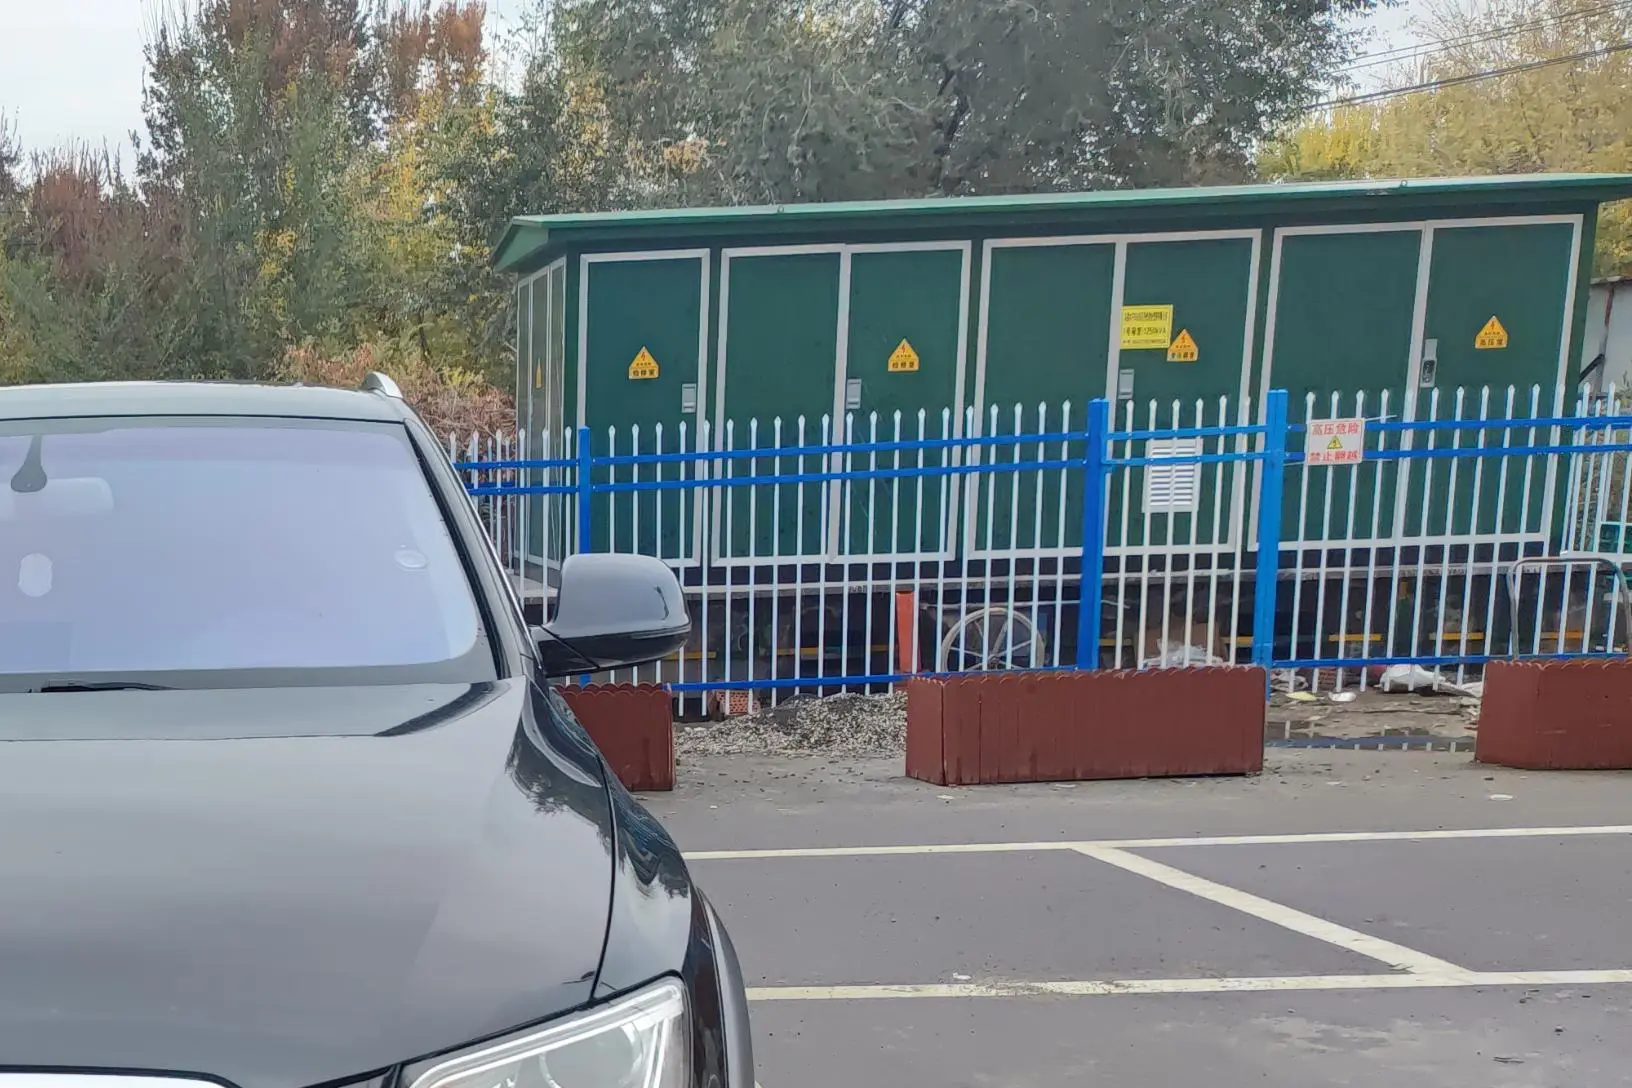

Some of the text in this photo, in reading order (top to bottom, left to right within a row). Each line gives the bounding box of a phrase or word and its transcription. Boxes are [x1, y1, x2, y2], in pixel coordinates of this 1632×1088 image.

[1312, 423, 1359, 435] 高压危险
[1309, 451, 1358, 462] 禁止翻越
